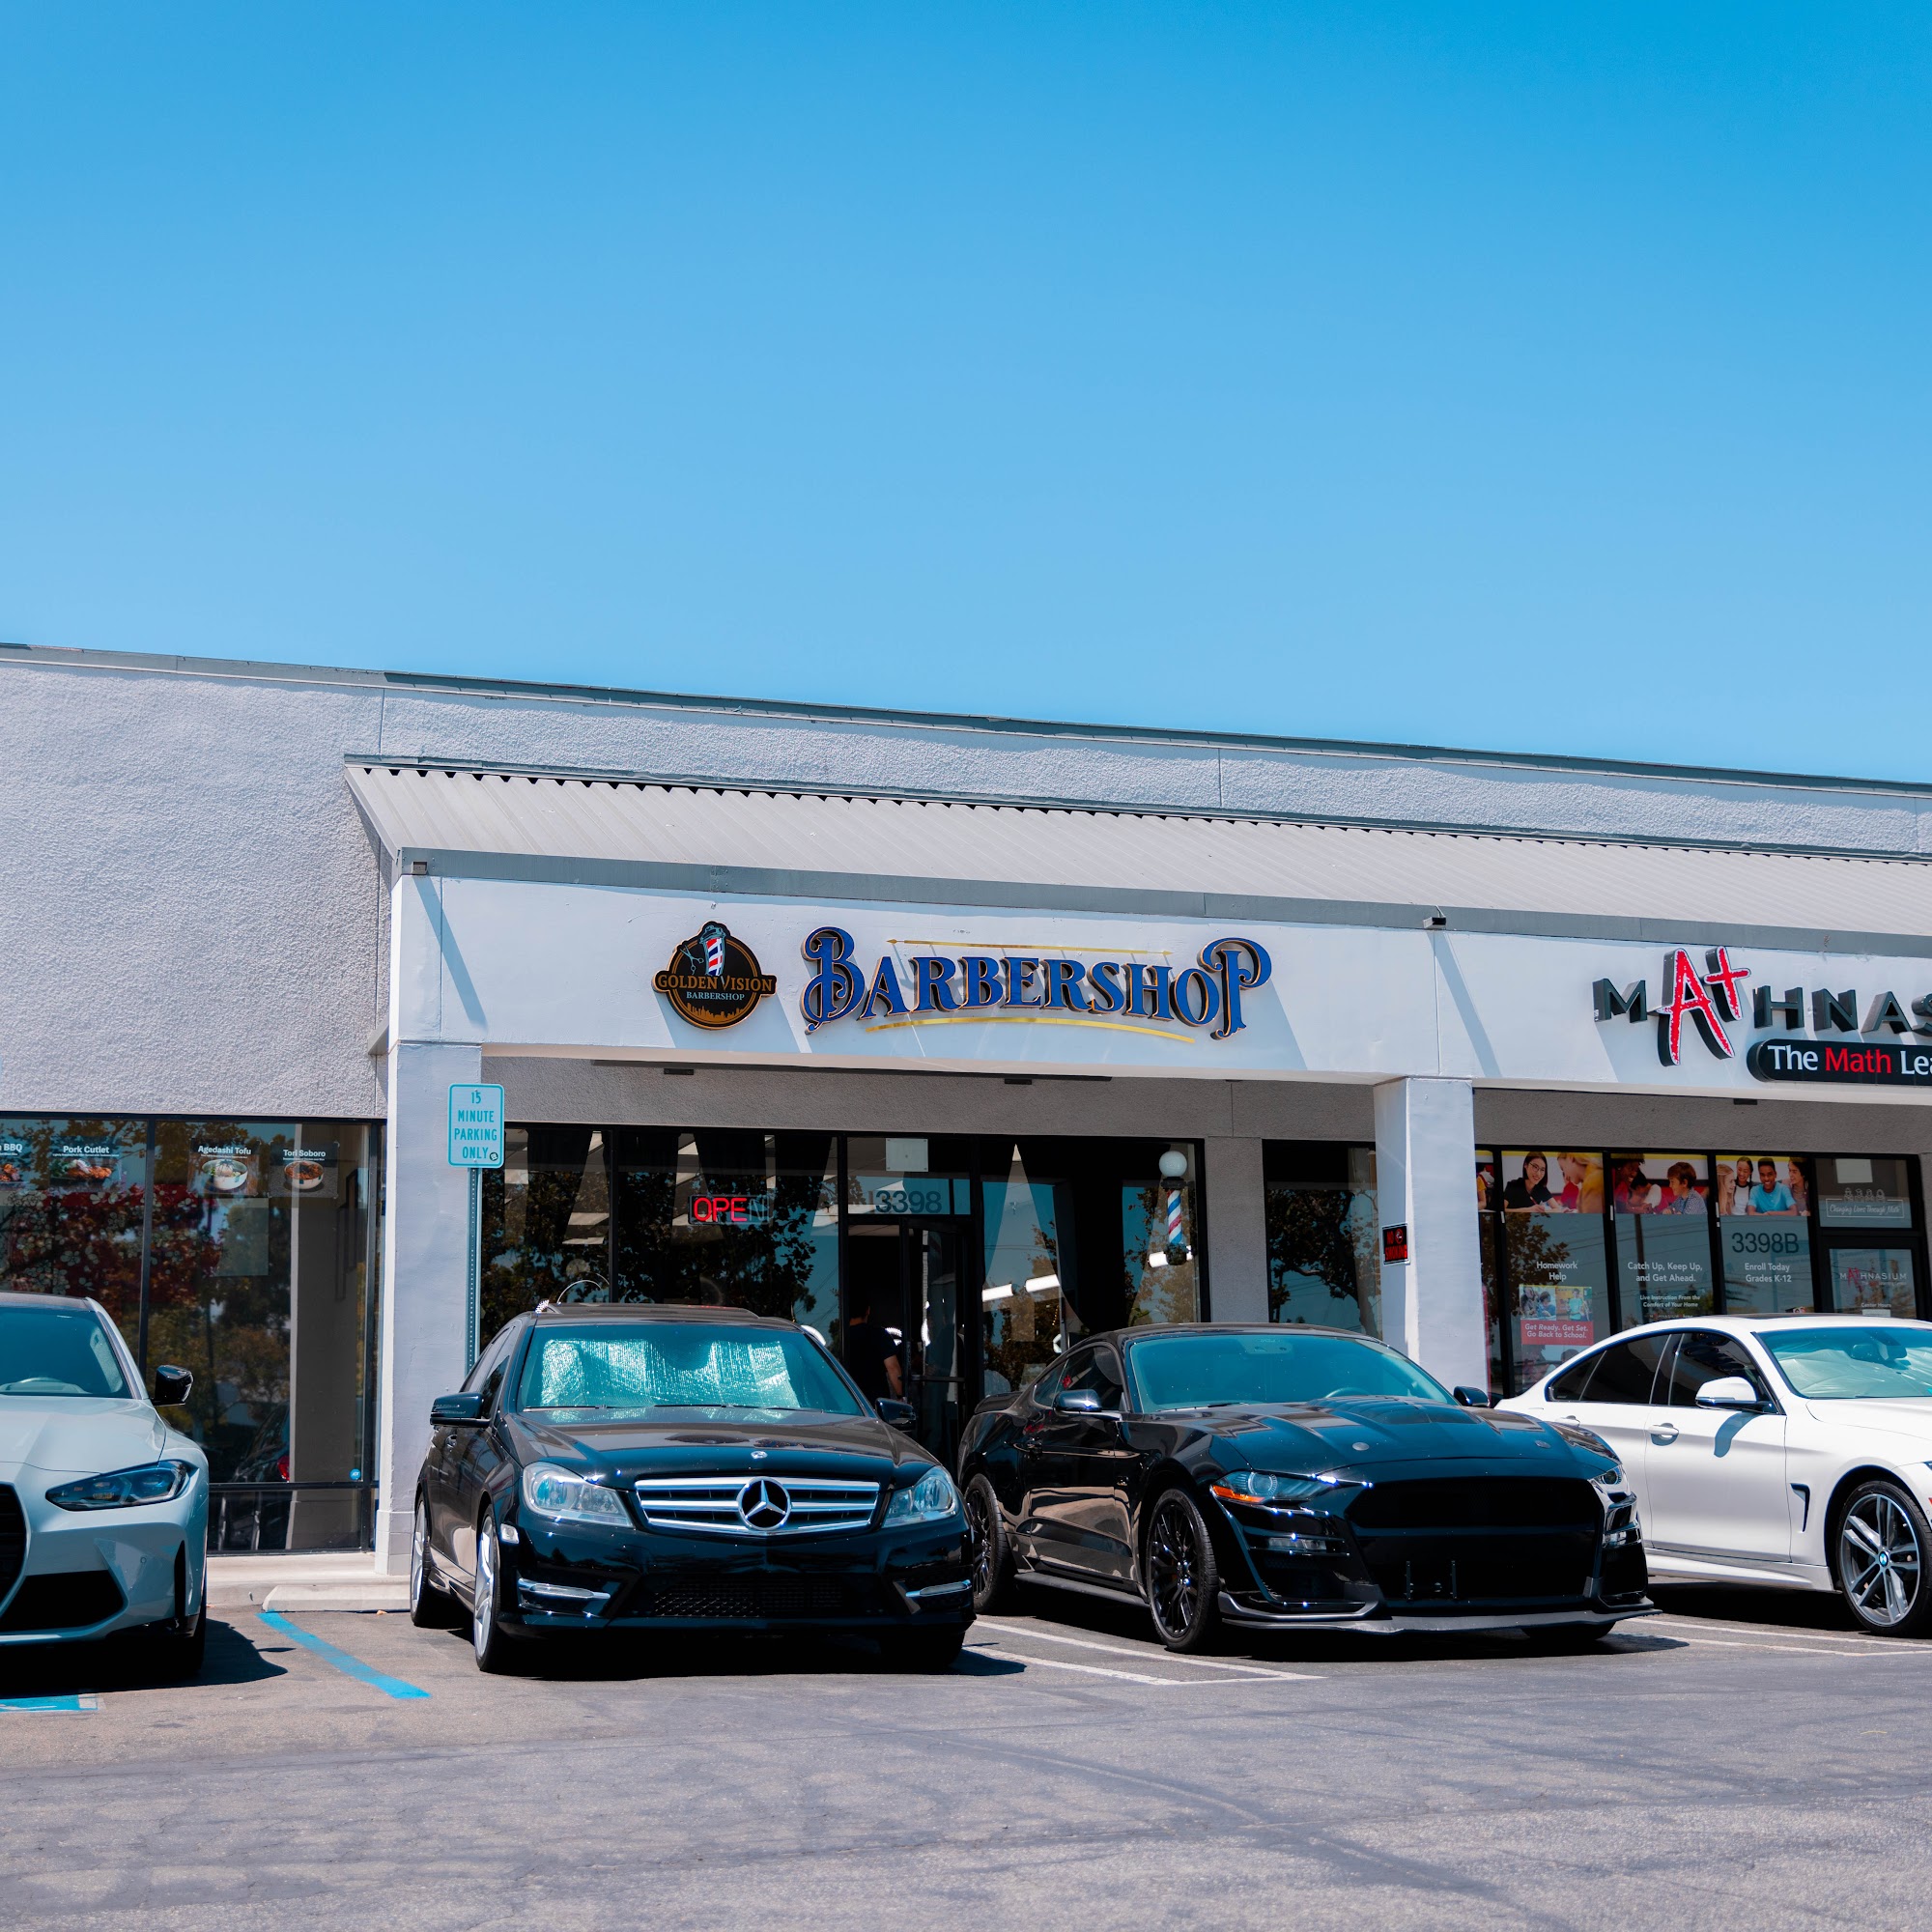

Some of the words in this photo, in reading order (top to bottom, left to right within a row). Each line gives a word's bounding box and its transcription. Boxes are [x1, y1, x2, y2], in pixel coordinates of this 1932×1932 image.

[658, 974, 718, 989] GOLDEN
[721, 975, 773, 992] VISION
[801, 925, 1272, 1039] BARBERSHOP
[686, 991, 745, 1001] BARBERSHOP
[1767, 1044, 1818, 1070] The
[1825, 1047, 1891, 1073] Math
[1900, 1050, 1932, 1075] Le
[471, 1092, 481, 1104] 15
[458, 1110, 495, 1122] MINUTE
[454, 1128, 497, 1141] PARKING
[3, 1143, 23, 1152] BBQ
[198, 1146, 234, 1155] Agedashi
[462, 1147, 489, 1159] ONLY
[875, 1190, 943, 1213] 3398
[1731, 1233, 1800, 1254] 3398B
[1536, 1261, 1577, 1269] Homework
[1627, 1262, 1650, 1270] Catch
[1652, 1262, 1665, 1271] Up,
[1667, 1262, 1688, 1271] Keep
[1689, 1262, 1703, 1271] Up,
[1768, 1263, 1790, 1272] Today
[1548, 1272, 1567, 1282] Help
[1635, 1273, 1650, 1282] and
[1652, 1273, 1667, 1282] Get
[1669, 1273, 1696, 1282] Ahead.
[1746, 1274, 1773, 1283] Grades
[1774, 1274, 1792, 1283] K-12
[1538, 1323, 1560, 1332] Ready.
